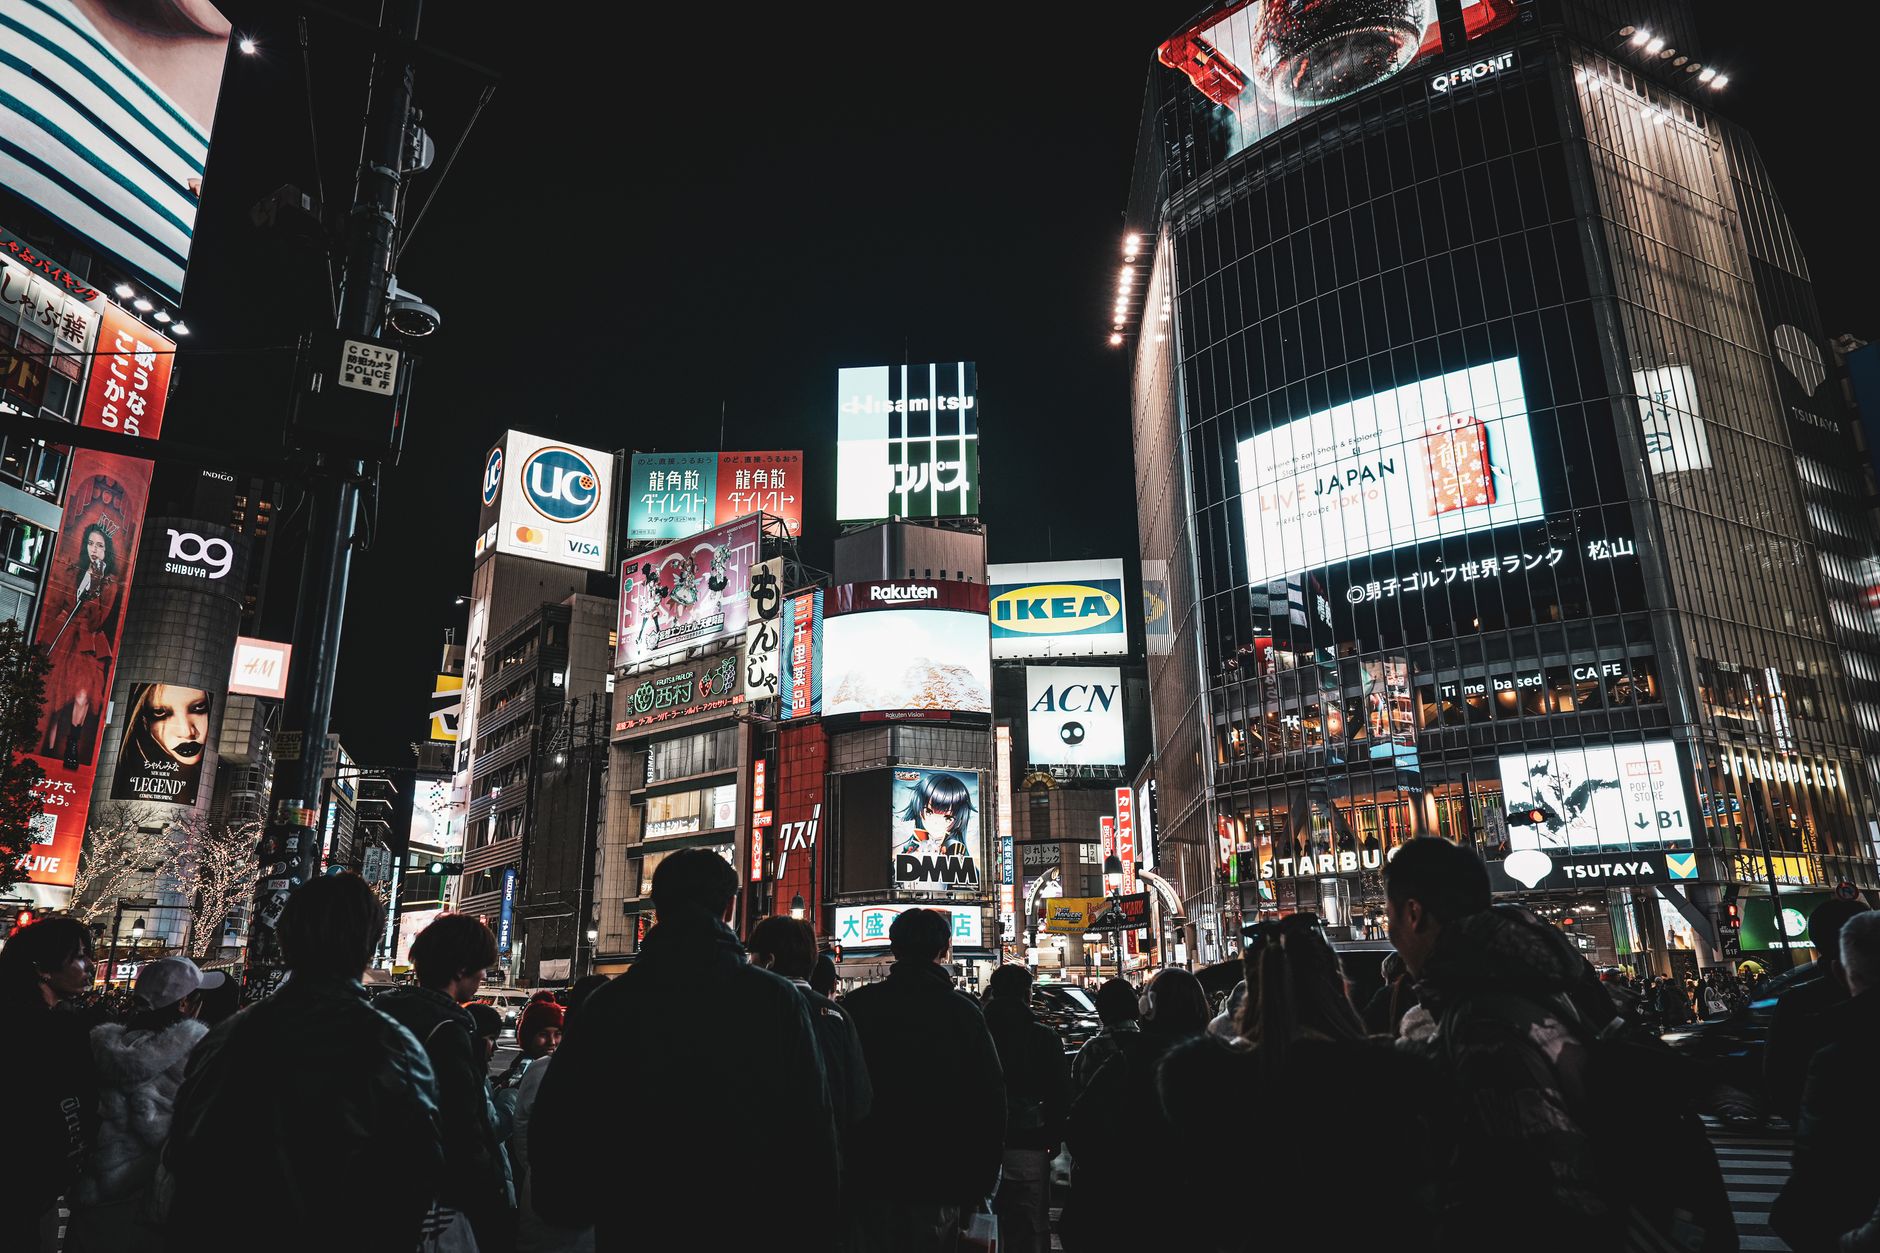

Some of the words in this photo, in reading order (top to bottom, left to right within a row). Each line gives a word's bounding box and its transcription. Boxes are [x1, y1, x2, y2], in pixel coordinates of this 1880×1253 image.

[1432, 53, 1513, 93] QFRONT
[347, 354, 393, 371] 防犯カメラ
[349, 345, 394, 362] CCTV
[102, 330, 134, 428] ここから
[346, 364, 391, 381] POLICE
[202, 470, 234, 482] INDIGO
[649, 469, 700, 491] 龍角散
[735, 468, 786, 490] 龍角散
[1314, 457, 1395, 497] JAPAN
[640, 493, 708, 514] ダイレクト
[167, 528, 234, 579] 109
[568, 540, 600, 556] VISA
[1587, 537, 1634, 561] 松山
[165, 562, 207, 578] SHIBUYA
[870, 584, 938, 601] Rakuten
[997, 596, 1111, 622] IKEA
[747, 564, 780, 694] もんじゃ
[791, 599, 809, 711] 三千里薬品
[1442, 682, 1485, 699] Time
[1494, 673, 1543, 691] based
[1573, 663, 1622, 680] CAFE
[655, 681, 693, 709] 西村
[1029, 684, 1119, 713] ACN
[144, 760, 180, 772] ちゃんみな
[1118, 796, 1132, 853] カラオケ
[1657, 809, 1684, 829] B1
[1024, 855, 1060, 865] クリニック
[1033, 845, 1060, 855] れいわ
[895, 853, 978, 885] DMM
[1562, 861, 1655, 879] TSUTAYA
[842, 912, 972, 939] 大盛店
